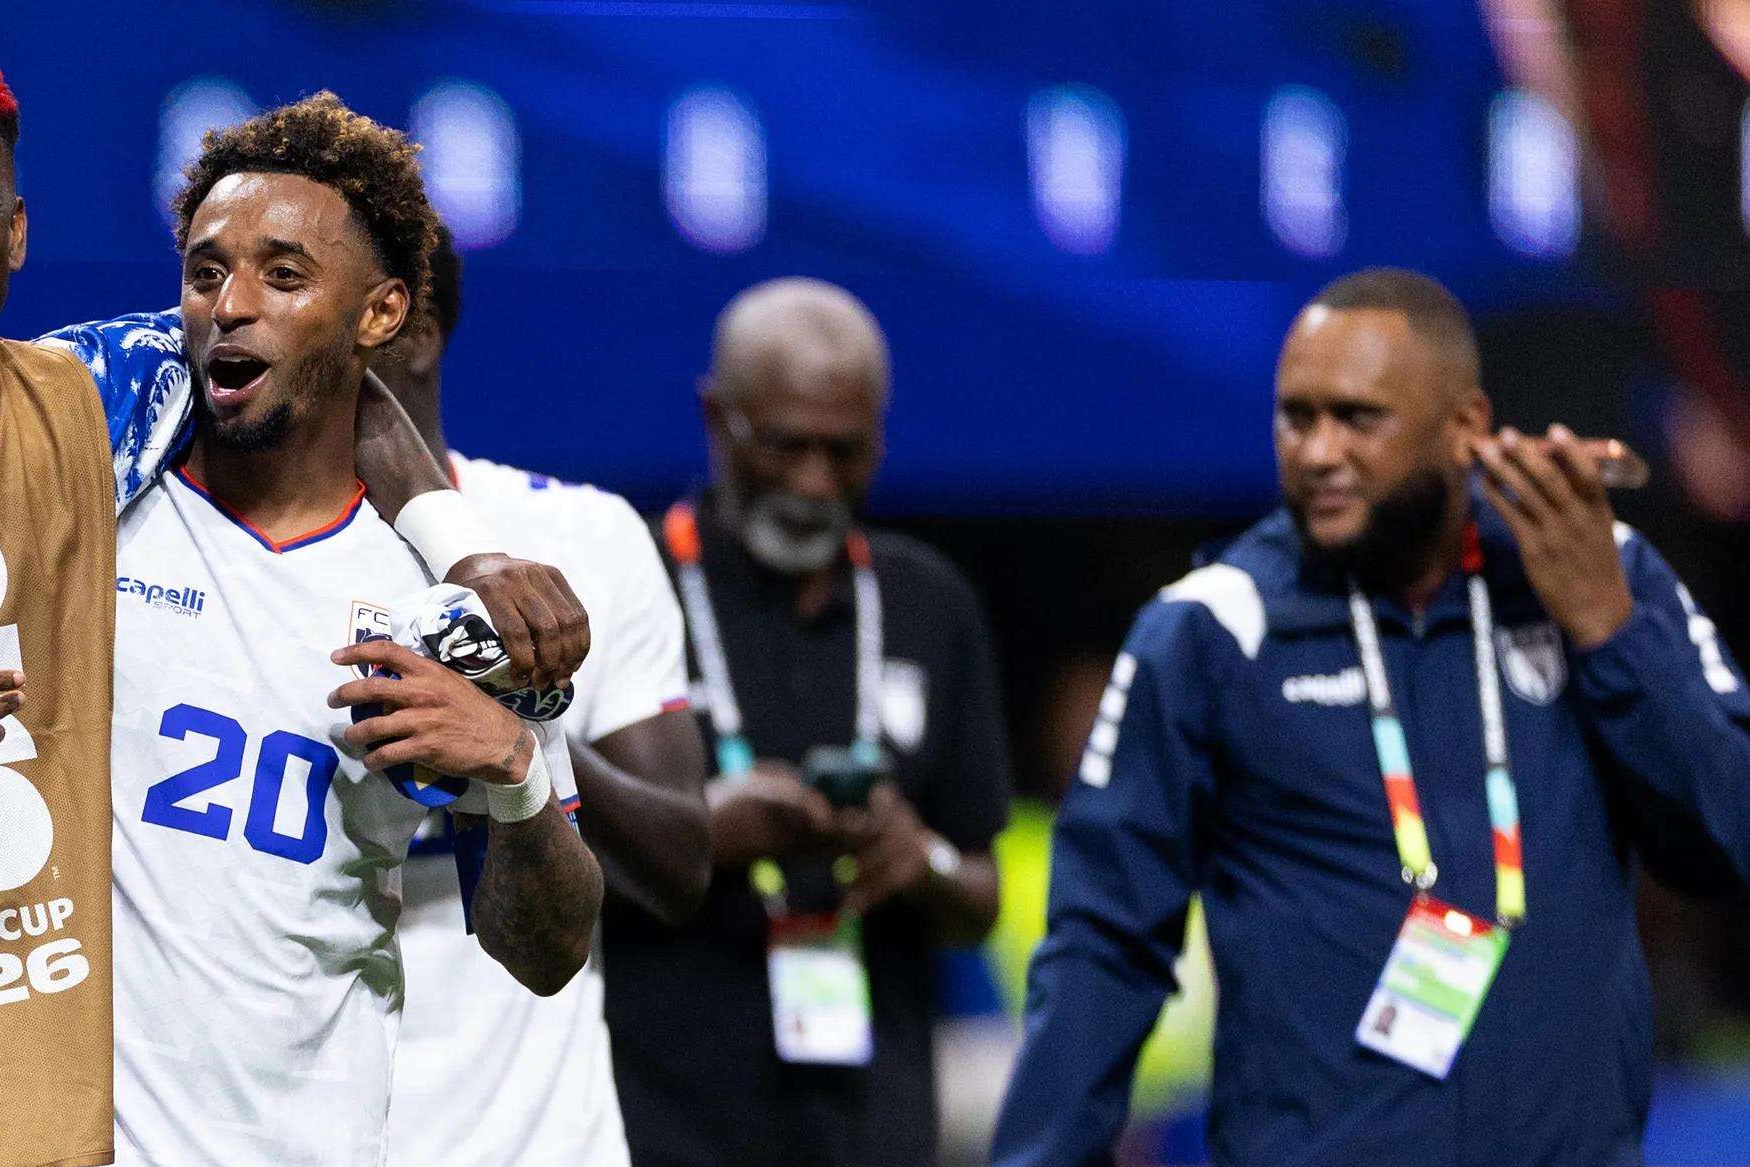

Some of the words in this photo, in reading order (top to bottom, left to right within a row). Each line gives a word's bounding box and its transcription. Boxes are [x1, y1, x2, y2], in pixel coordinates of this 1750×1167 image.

[115, 577, 205, 611] capelli
[358, 607, 390, 626] FC
[141, 703, 339, 865] 20
